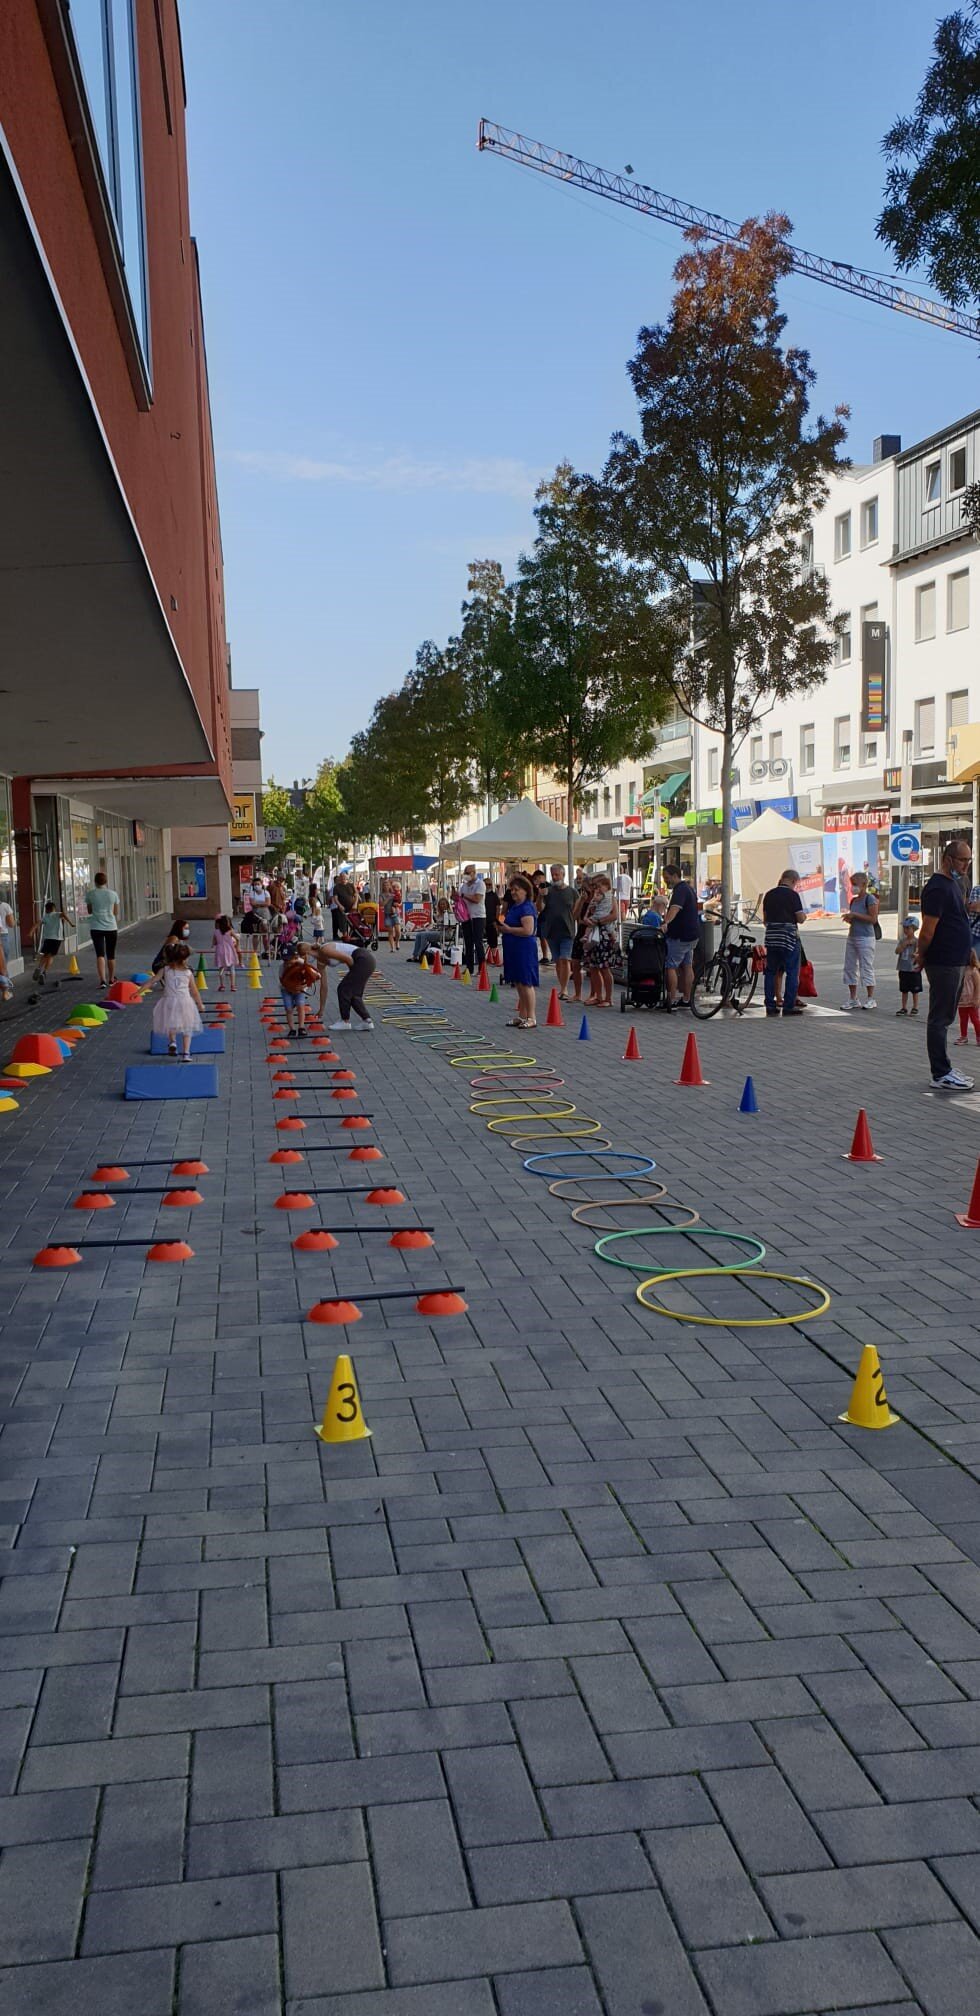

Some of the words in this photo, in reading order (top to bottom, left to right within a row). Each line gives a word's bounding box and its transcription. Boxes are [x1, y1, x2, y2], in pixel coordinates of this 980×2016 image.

[871, 628, 880, 638] M
[826, 814, 849, 826] OUTLET
[858, 812, 883, 825] OUTLET
[871, 1368, 888, 1407] 2
[336, 1382, 358, 1423] 3
